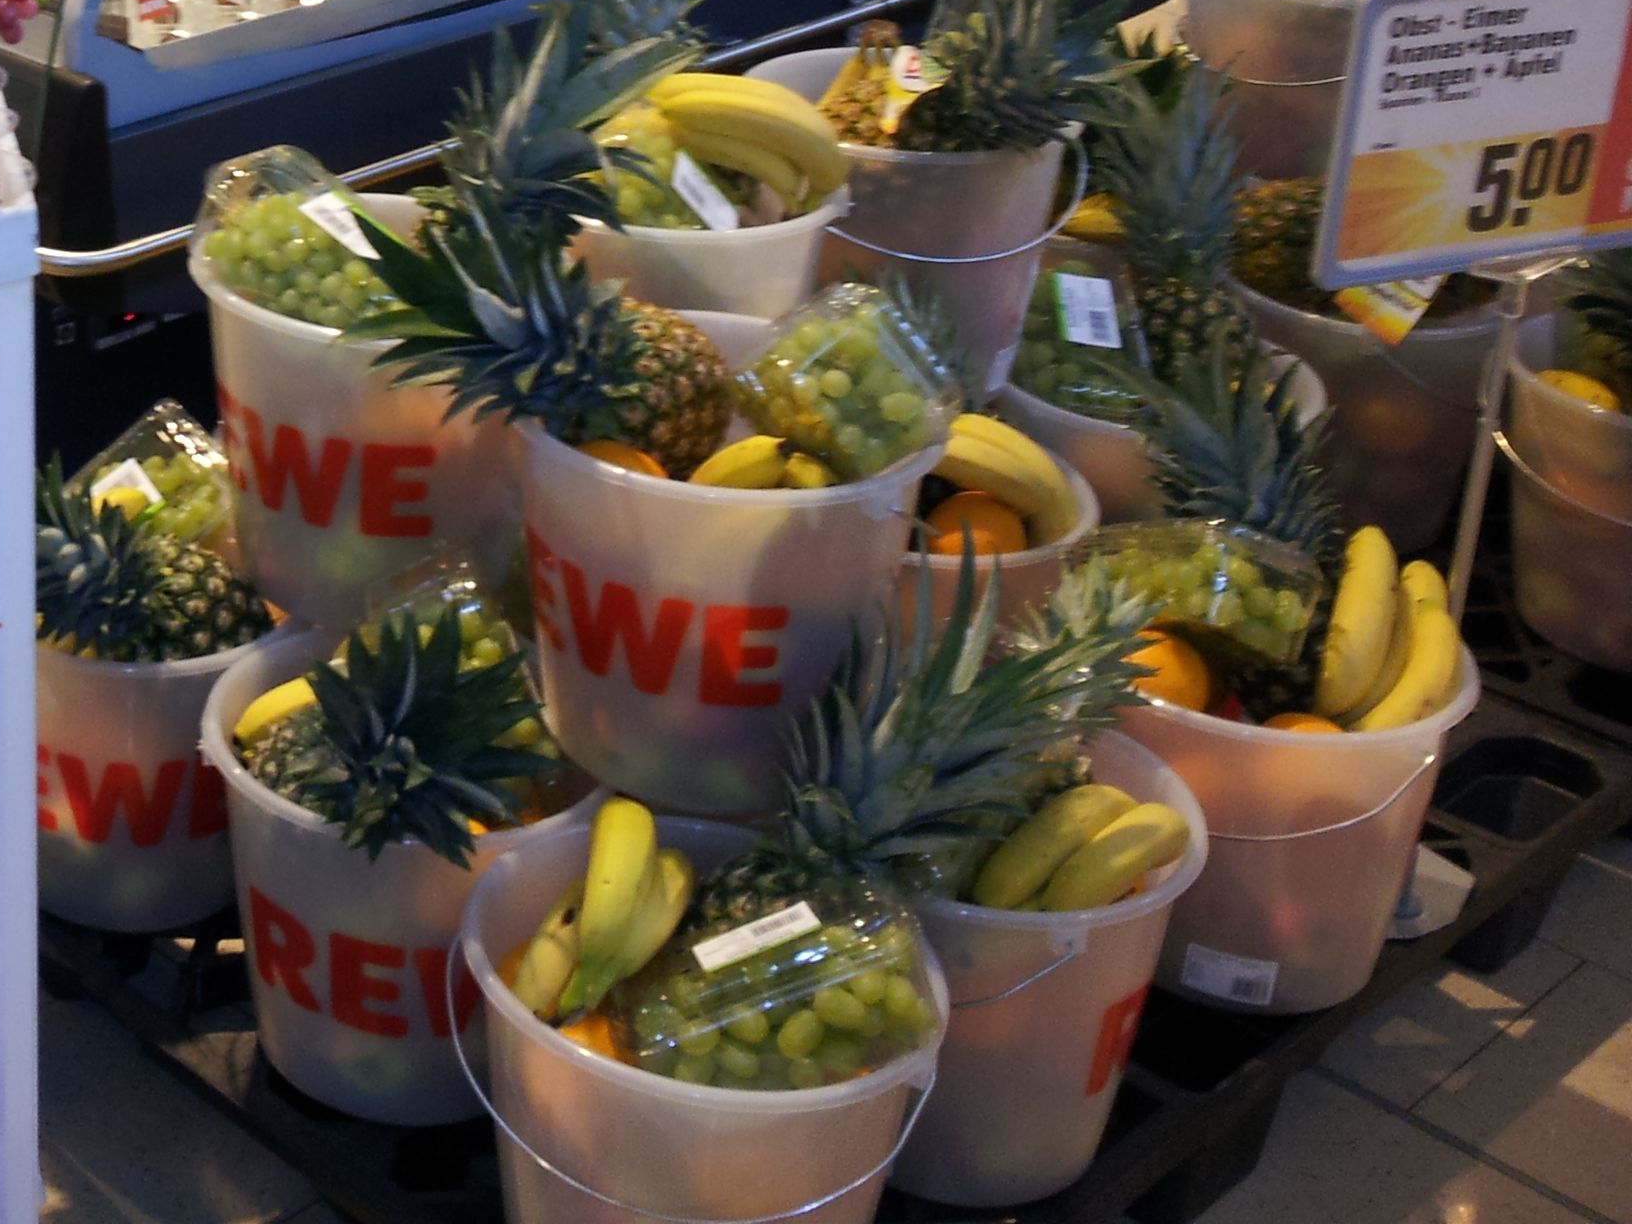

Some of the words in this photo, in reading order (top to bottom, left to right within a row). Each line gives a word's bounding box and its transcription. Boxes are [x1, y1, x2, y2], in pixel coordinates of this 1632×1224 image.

[1390, 14, 1443, 38] Obst
[1462, 6, 1529, 29] Eimer
[1381, 67, 1475, 93] Orangen
[1467, 132, 1597, 232] 5.00
